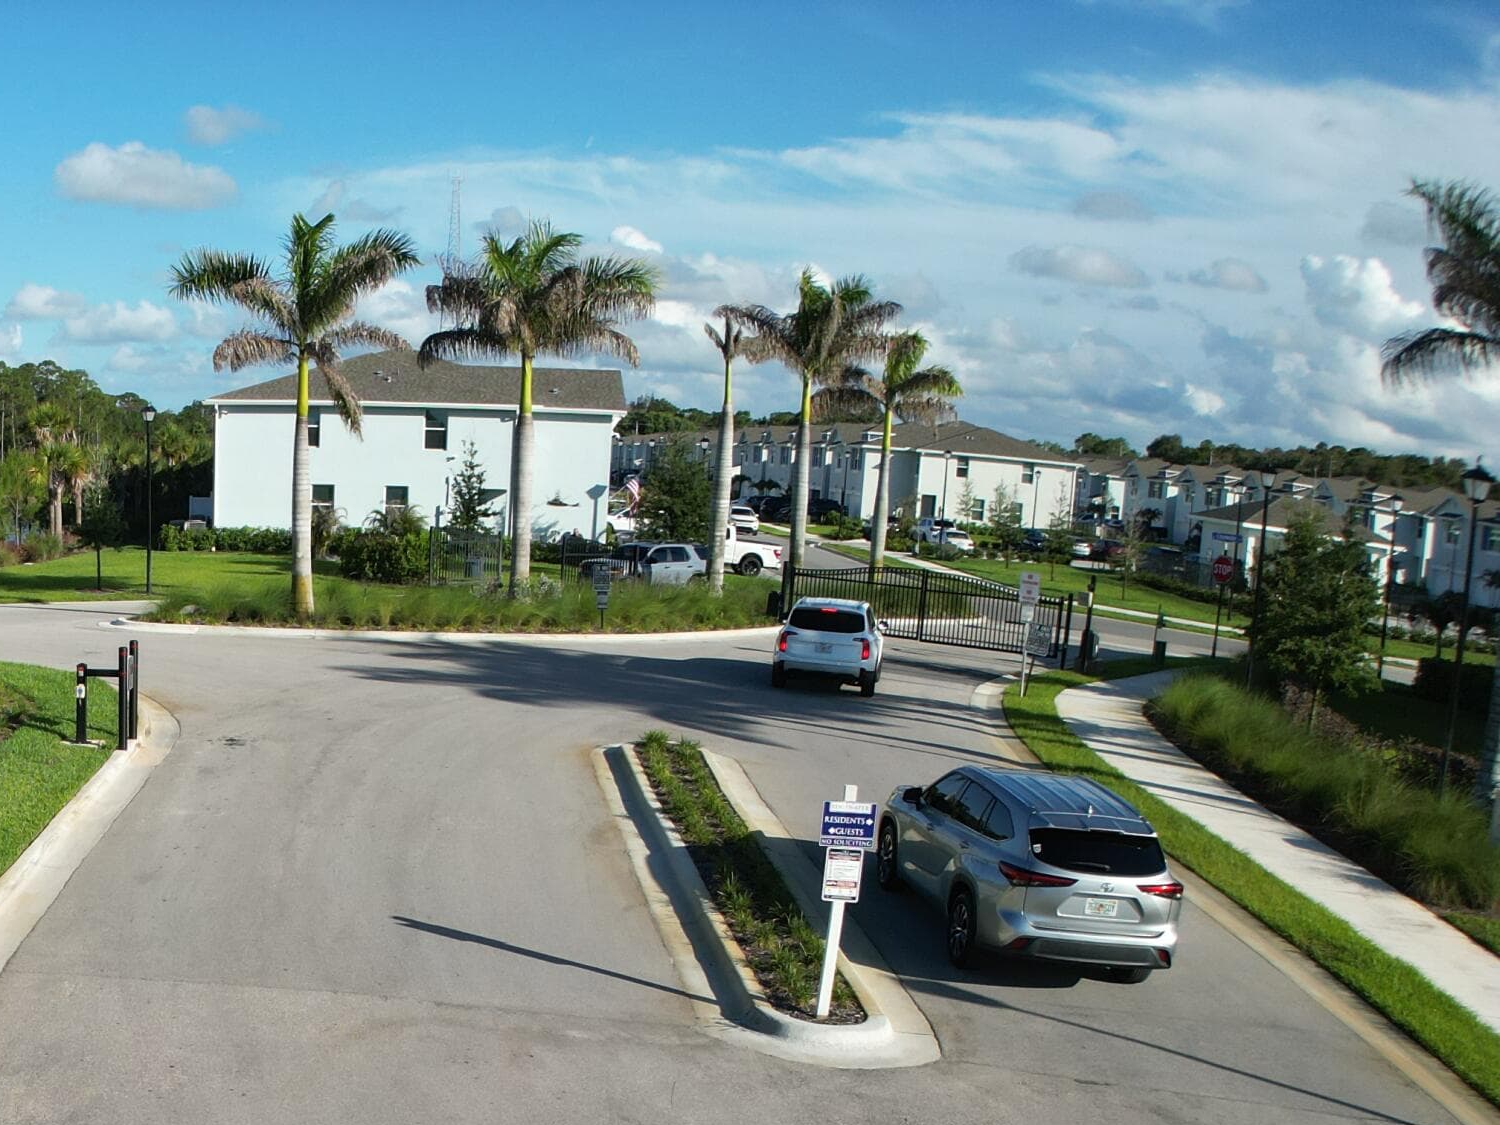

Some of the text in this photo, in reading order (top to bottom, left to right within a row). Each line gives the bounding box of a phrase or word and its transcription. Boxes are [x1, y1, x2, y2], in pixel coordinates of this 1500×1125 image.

[1213, 563, 1232, 576] STOP
[824, 816, 866, 825] RESIDENTS
[835, 827, 864, 836] GUESTS
